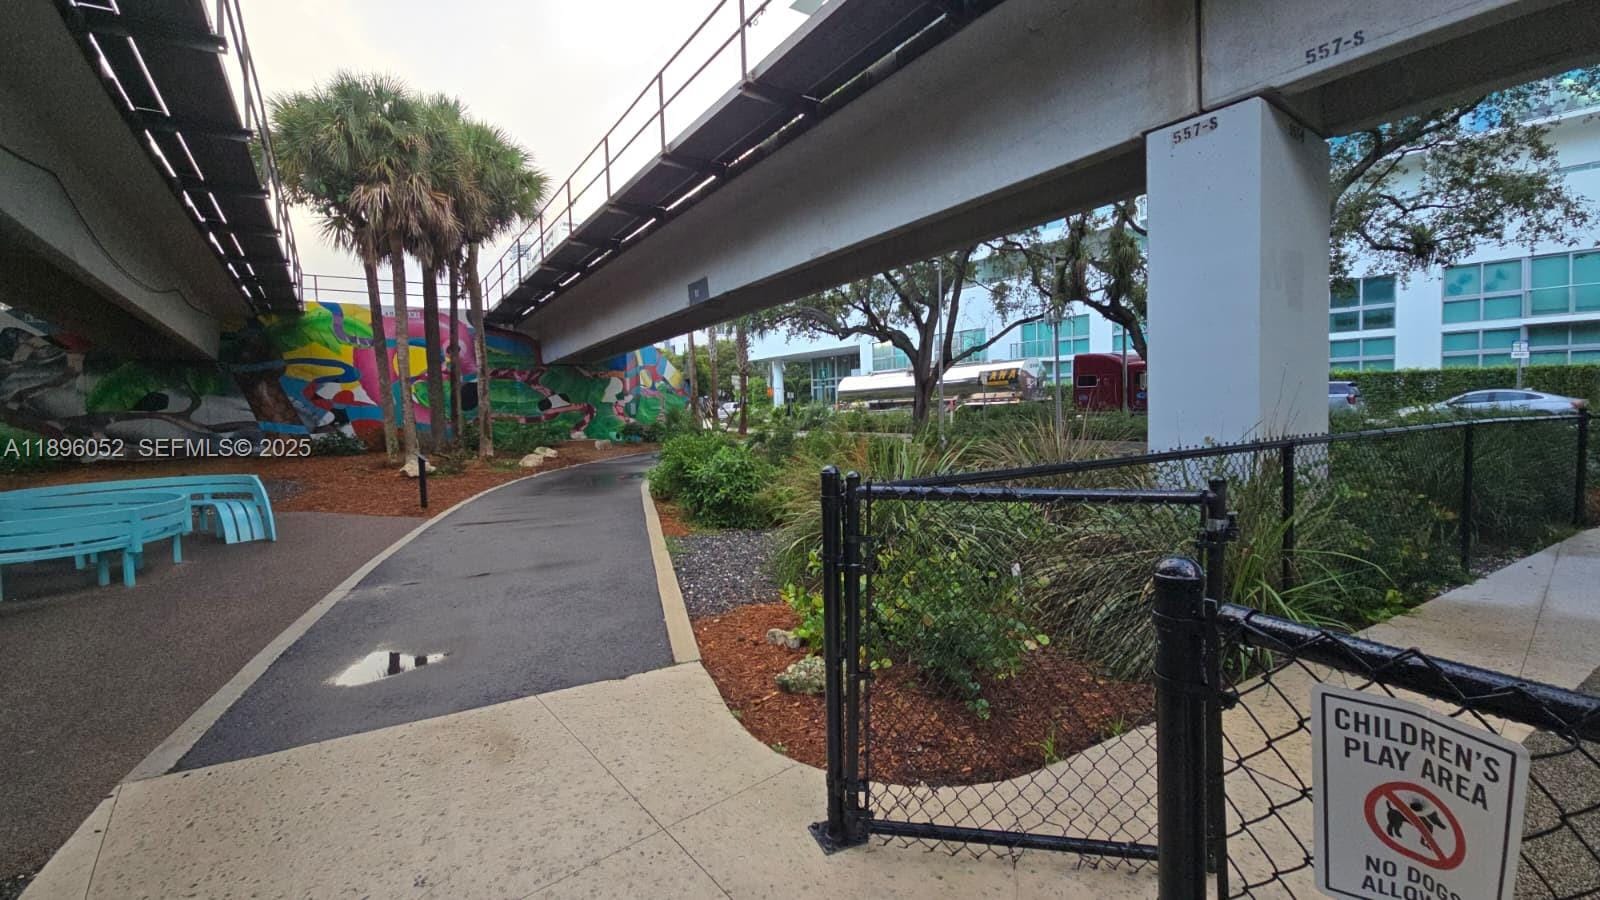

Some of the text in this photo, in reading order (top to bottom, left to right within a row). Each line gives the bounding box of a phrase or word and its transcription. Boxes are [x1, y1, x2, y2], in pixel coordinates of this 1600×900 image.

[1305, 29, 1365, 64] 557-S
[1172, 116, 1218, 144] 557-S
[1334, 708, 1500, 783] CHILDREN'S
[1344, 736, 1489, 812] PLAY AREA
[1365, 854, 1397, 878] NO
